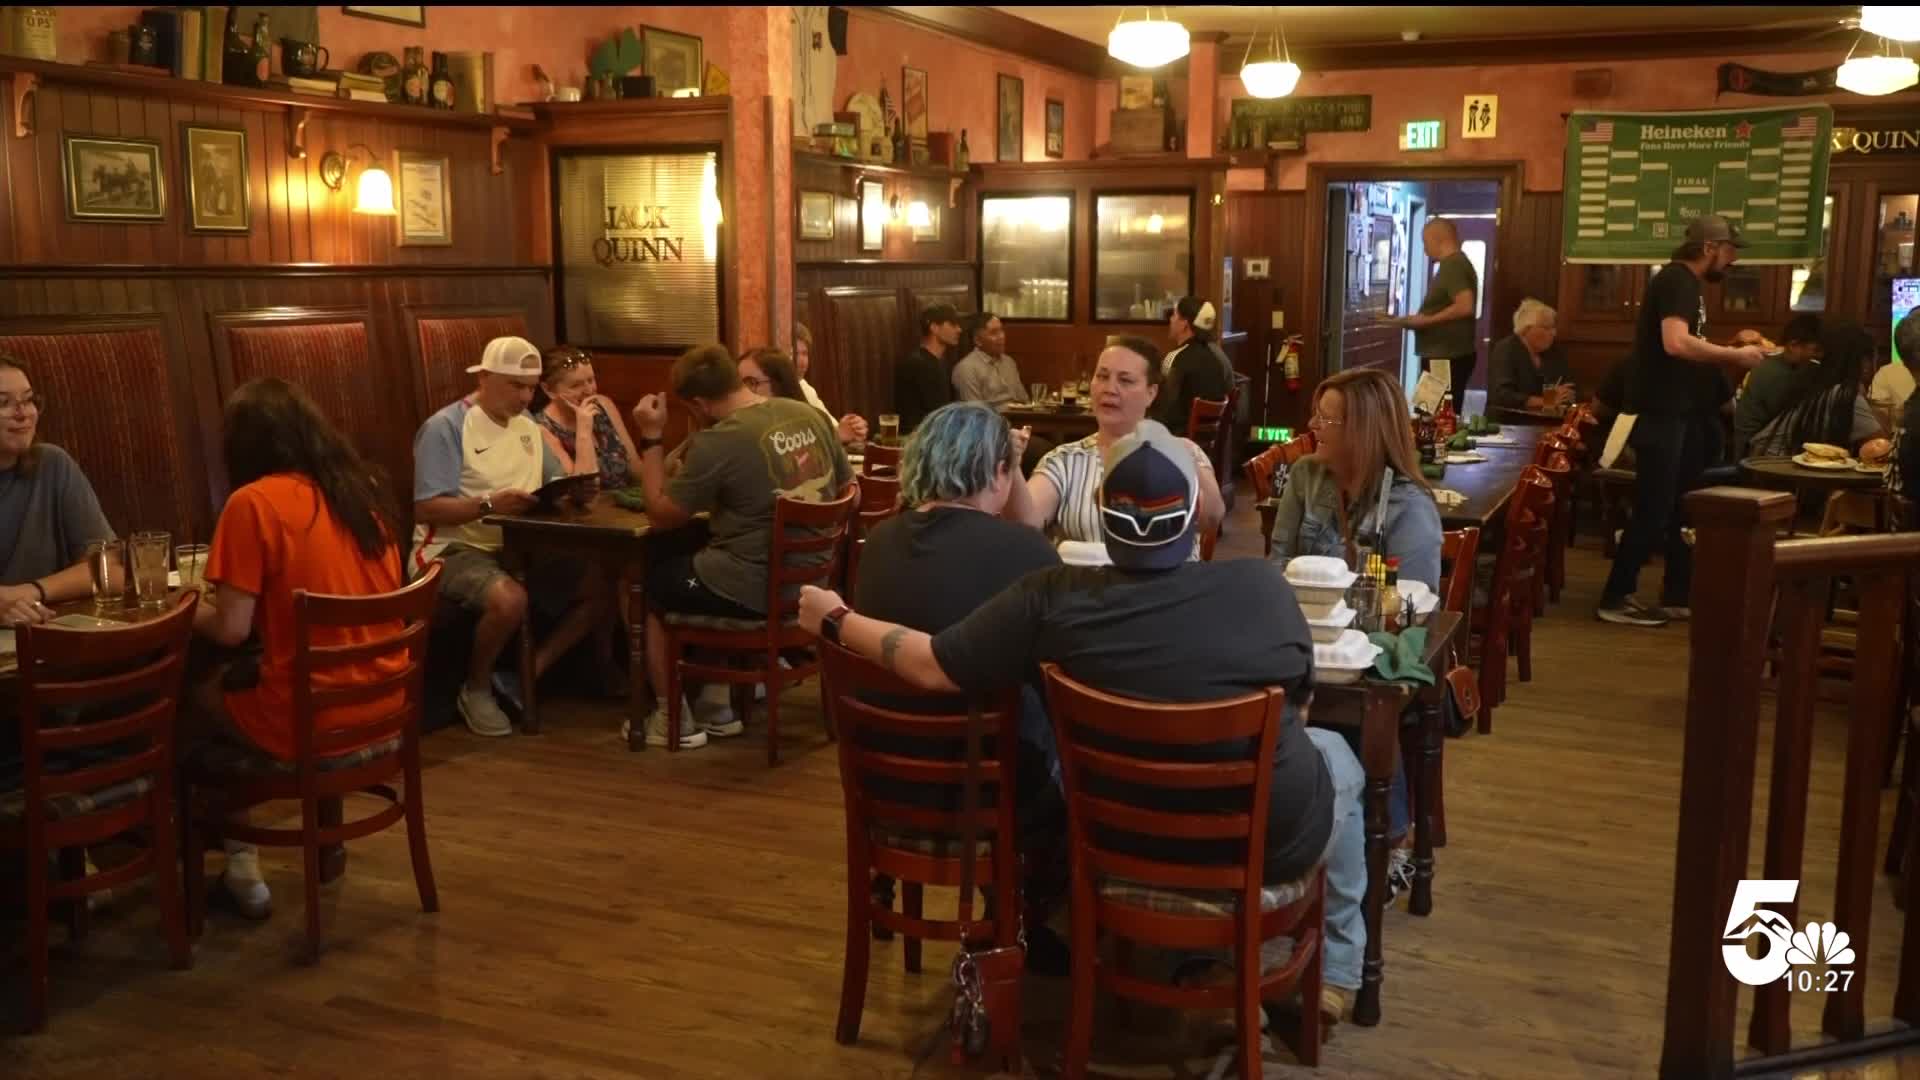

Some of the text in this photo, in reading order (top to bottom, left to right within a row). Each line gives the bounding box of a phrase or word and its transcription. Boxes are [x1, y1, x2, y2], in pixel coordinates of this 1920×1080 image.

[1407, 121, 1441, 149] EXIT
[1641, 124, 1728, 139] Heineken
[1640, 140, 1751, 151] Fans Have More Friends
[1677, 177, 1707, 185] FINAL
[604, 206, 670, 231] JACK
[592, 237, 685, 267] QUINN
[769, 427, 817, 455] Coors
